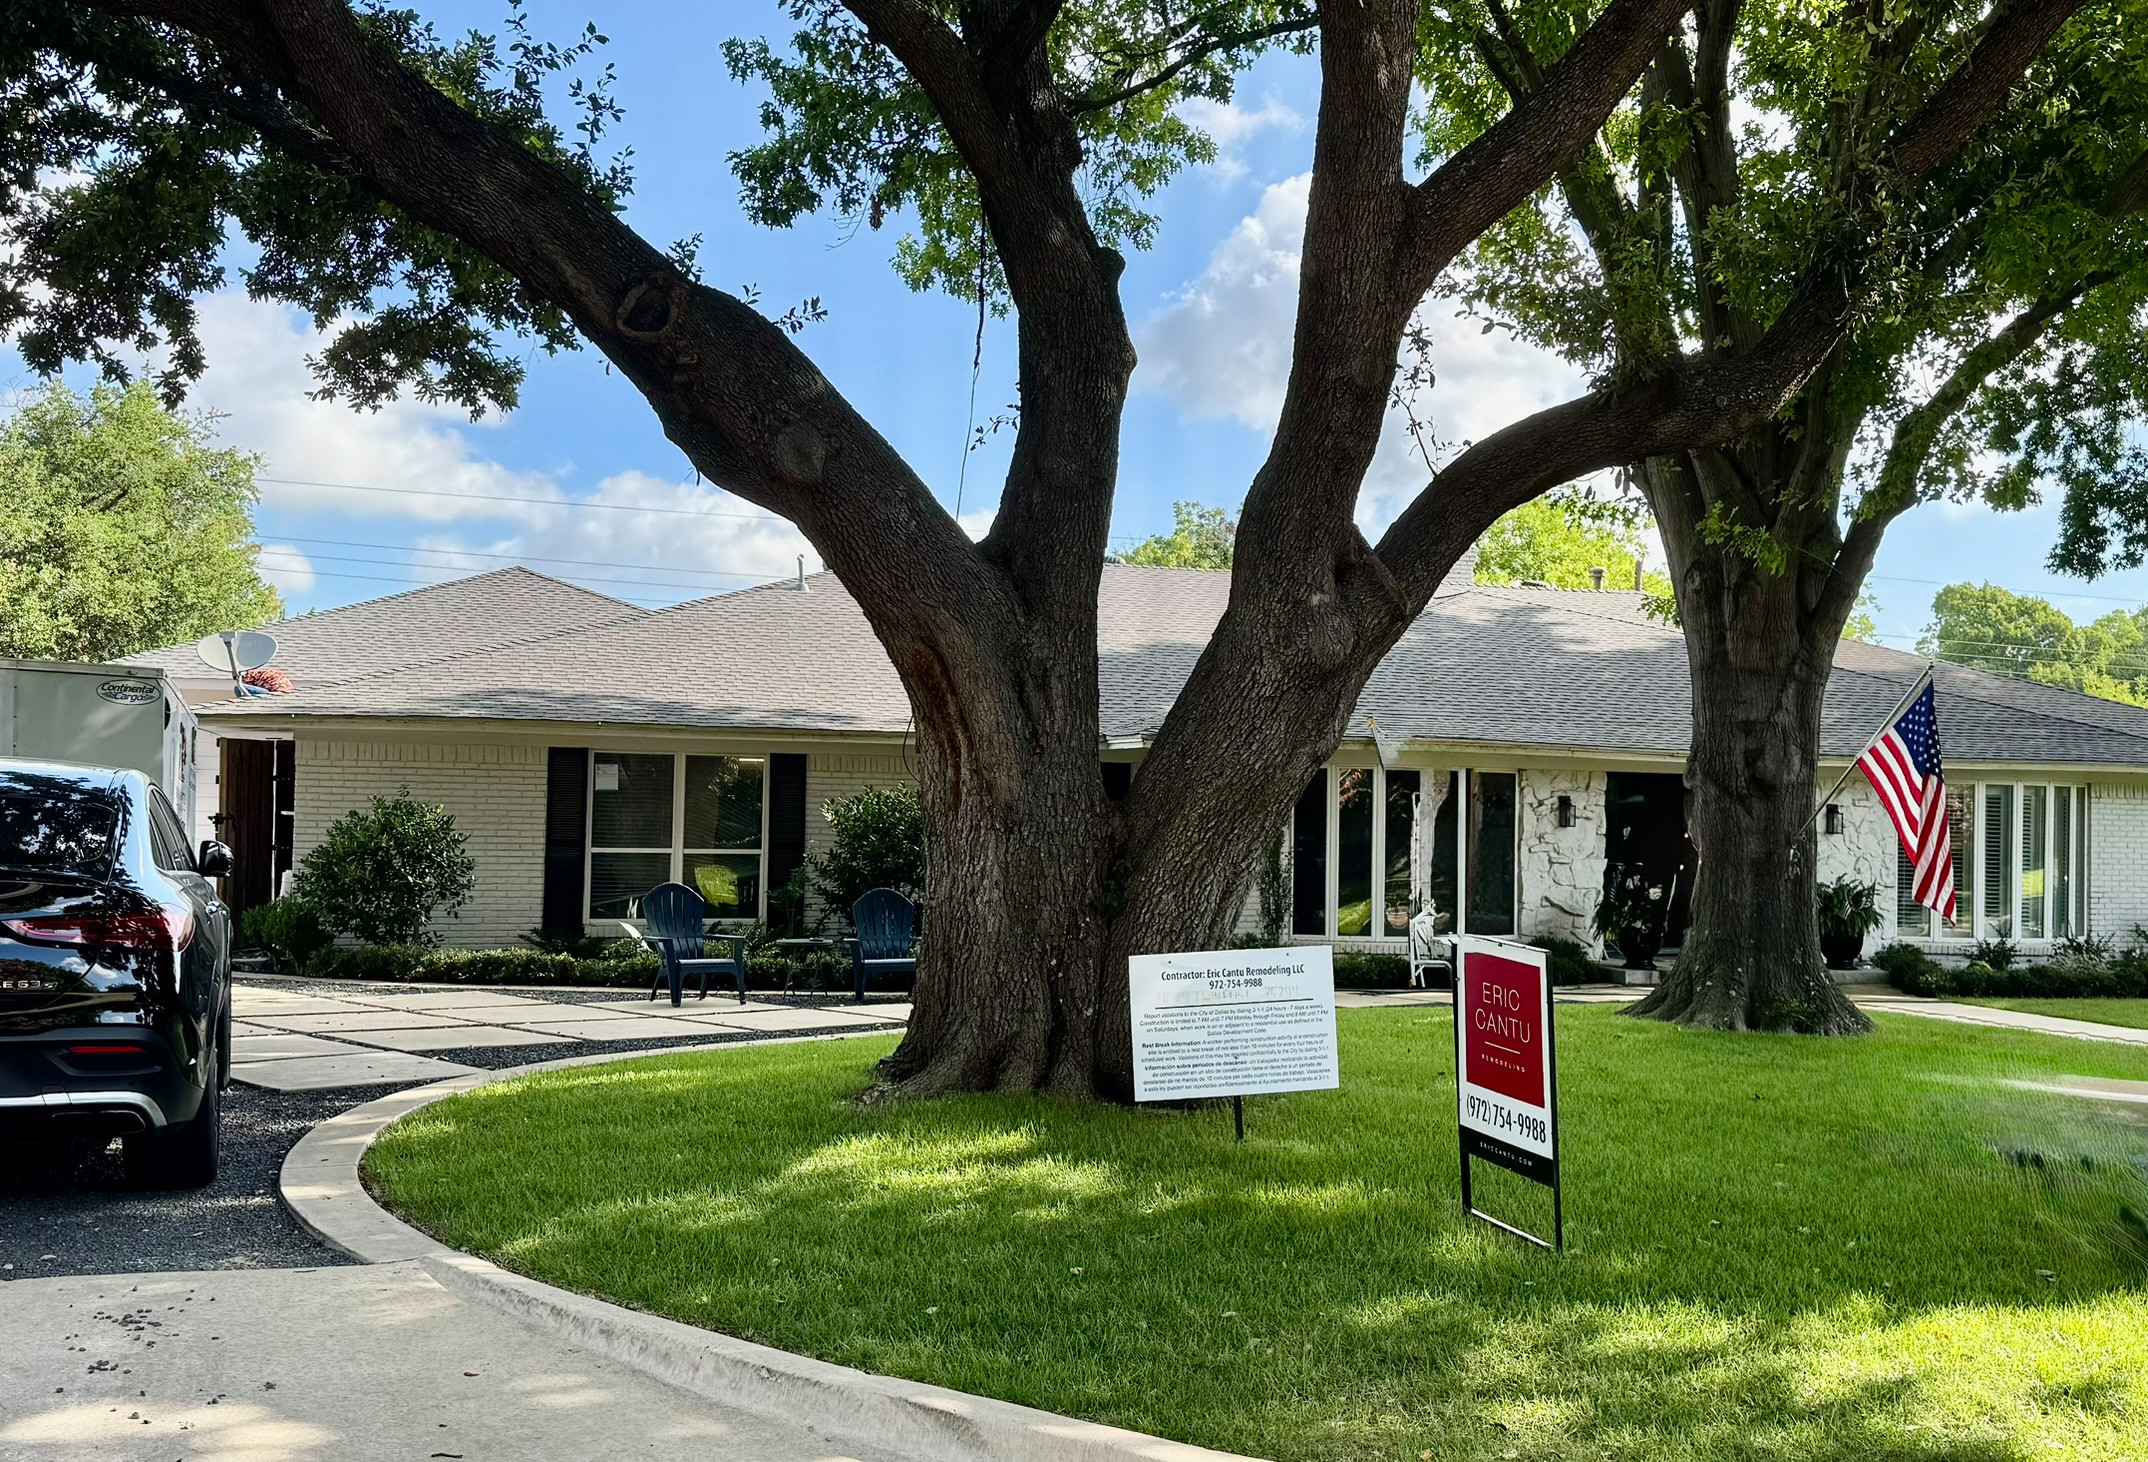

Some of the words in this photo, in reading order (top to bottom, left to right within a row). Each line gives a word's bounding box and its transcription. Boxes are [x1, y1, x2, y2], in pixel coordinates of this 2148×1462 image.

[101, 682, 155, 694] Continental
[114, 691, 142, 703] Cargo
[1161, 970, 1205, 981] Contractor:
[1207, 968, 1220, 979] Eric
[1222, 966, 1245, 977] Cantu
[1246, 965, 1291, 976] Remodeling
[1292, 963, 1305, 974] LLC
[1209, 977, 1263, 990] 972-754-9988
[1482, 981, 1520, 1011] ERIC
[1475, 1008, 1530, 1043] CANTU
[1481, 1053, 1526, 1073] REMODELING
[1480, 1141, 1532, 1167] ERICCANTU.COM
